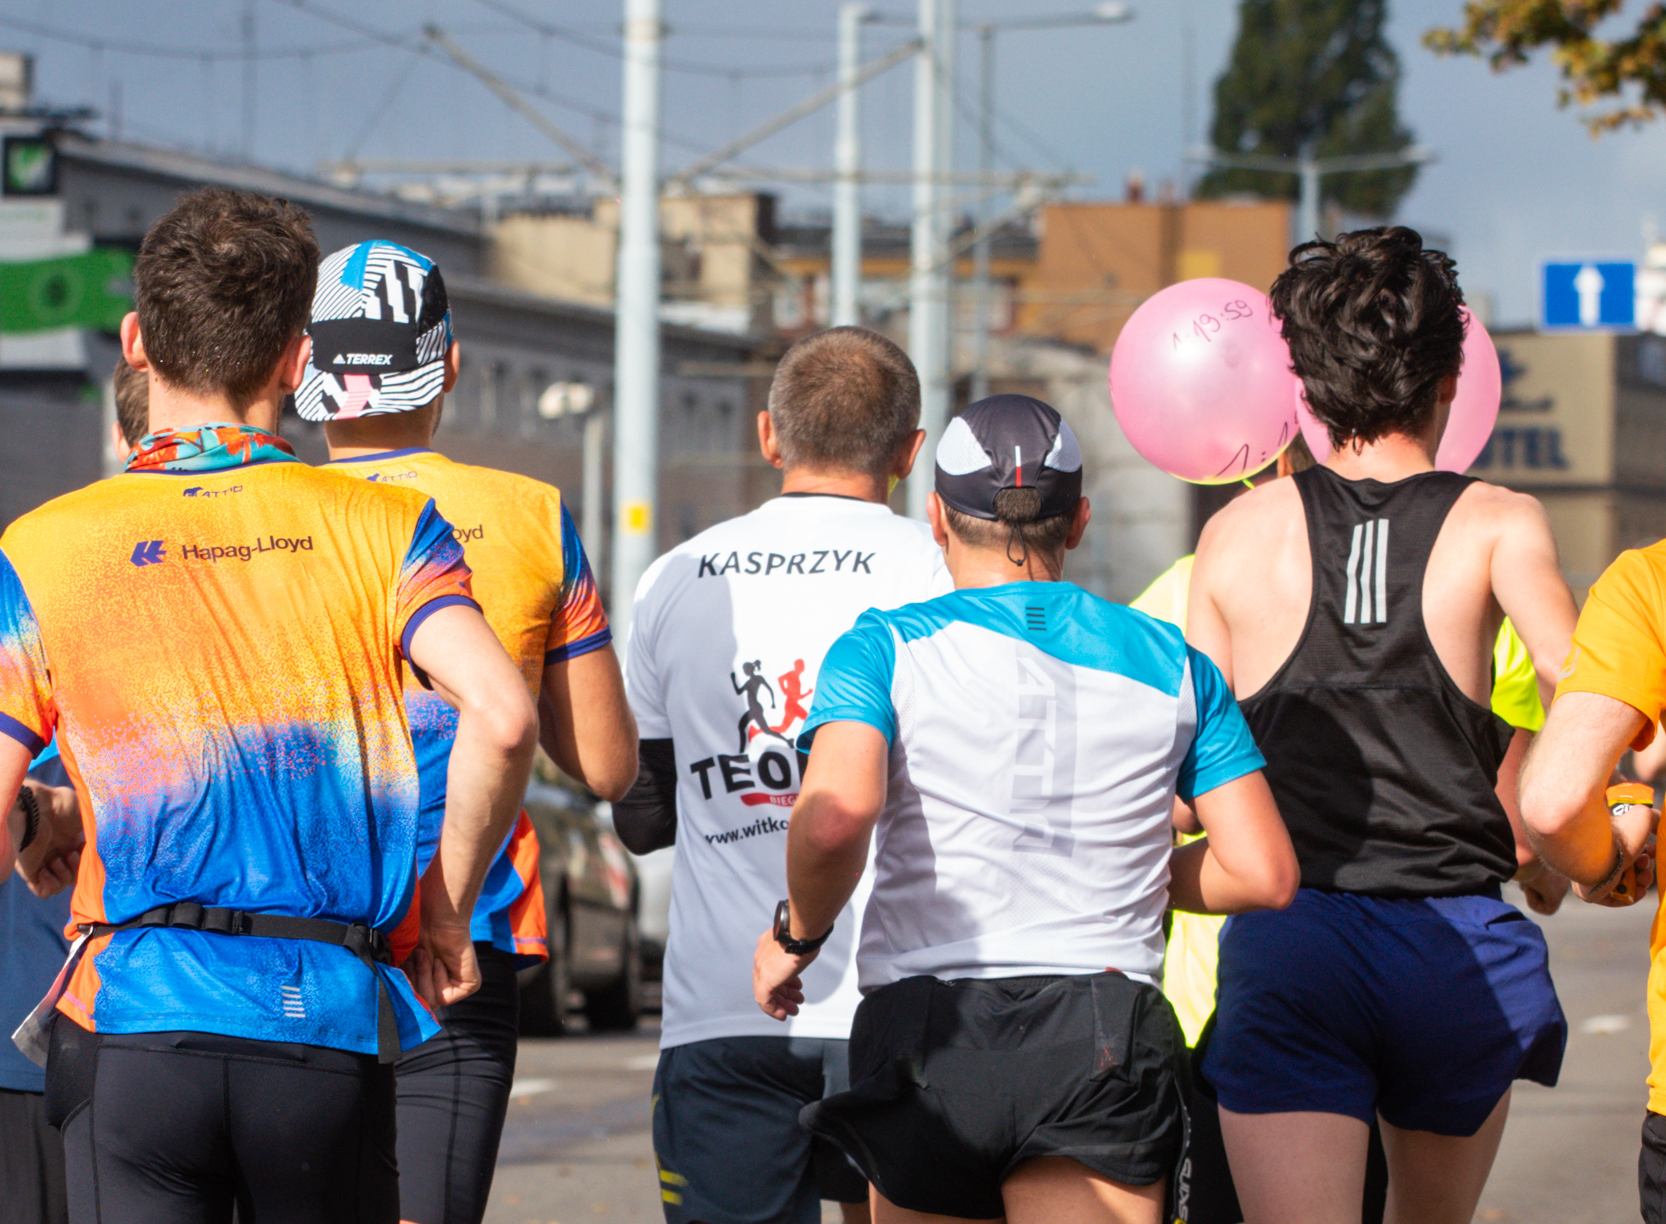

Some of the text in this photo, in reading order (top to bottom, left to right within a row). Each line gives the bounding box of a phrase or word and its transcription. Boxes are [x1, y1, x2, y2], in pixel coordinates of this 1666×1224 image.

[346, 353, 393, 365] TERREX
[182, 535, 314, 561] Hapag-Lloyd
[698, 550, 877, 578] KASPRZYK
[769, 795, 798, 806] BIEG
